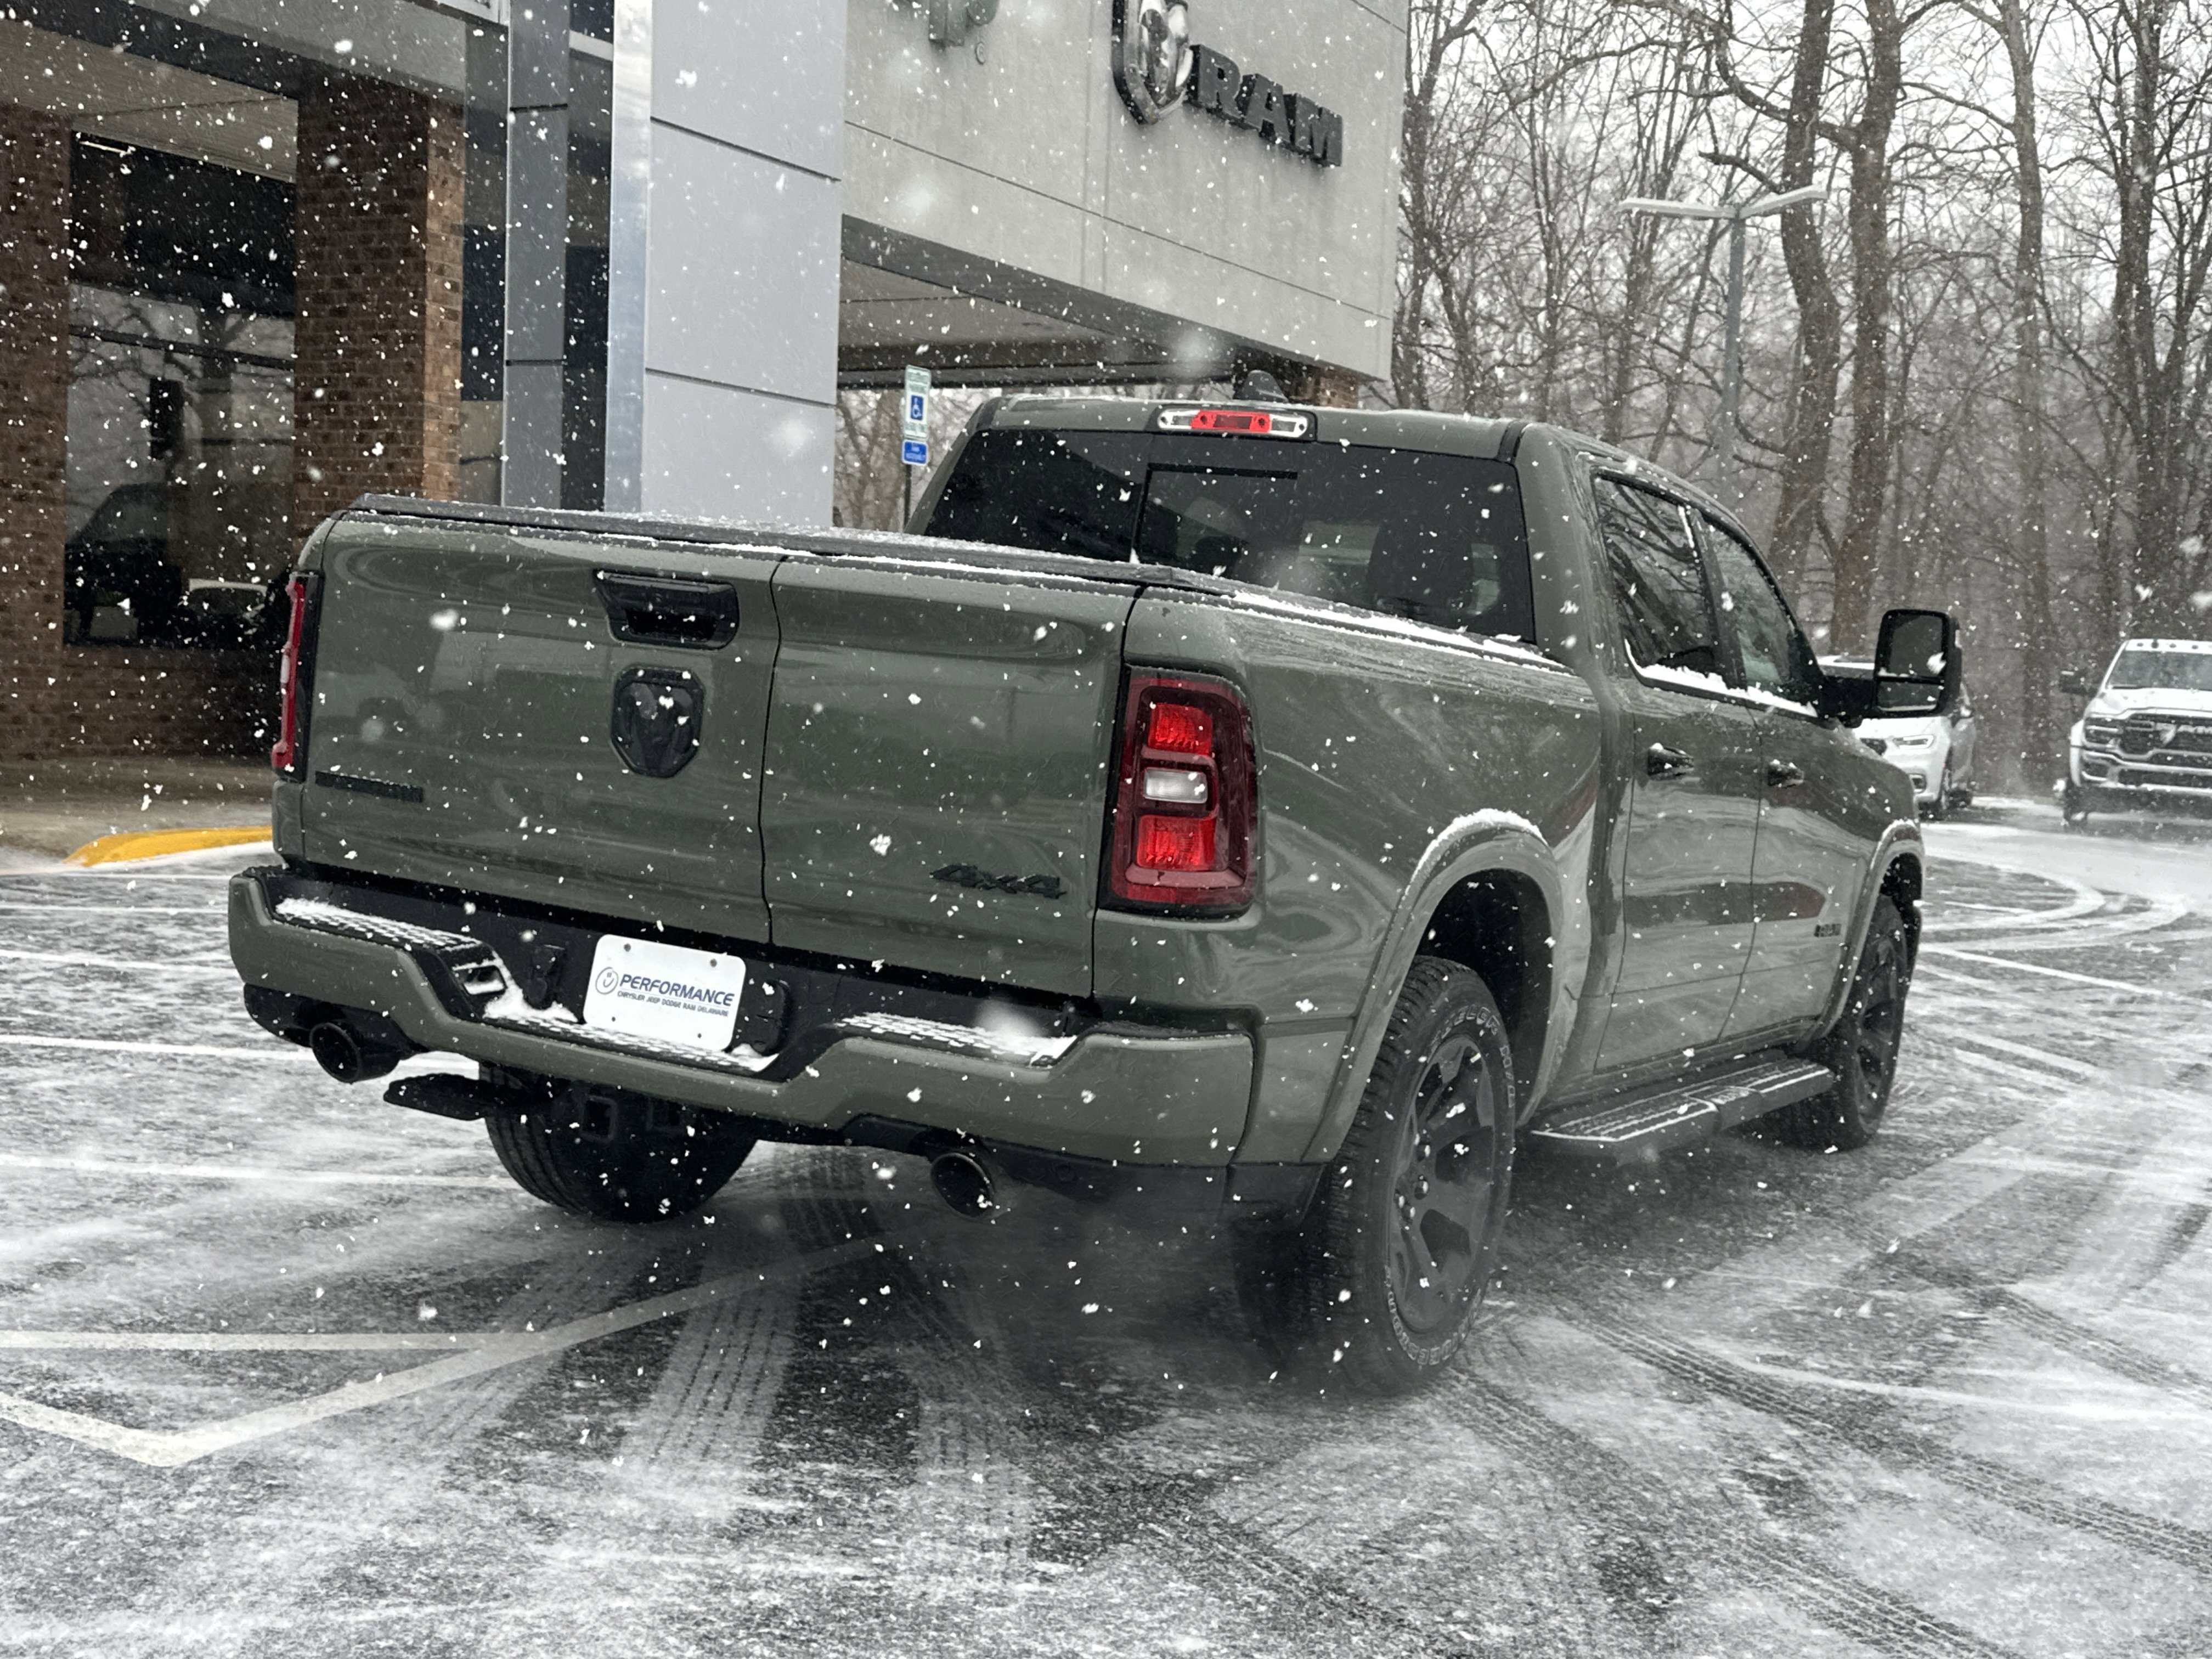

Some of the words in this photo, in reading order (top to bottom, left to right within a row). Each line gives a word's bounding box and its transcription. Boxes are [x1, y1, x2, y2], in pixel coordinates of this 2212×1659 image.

[1186, 44, 1343, 167] RAM
[617, 990, 645, 1001] CHRYSLER
[661, 998, 681, 1007] DODGE
[682, 1002, 696, 1011] RAM
[697, 1005, 728, 1017] DELAWARE
[619, 973, 734, 1006] PERFORMANCE
